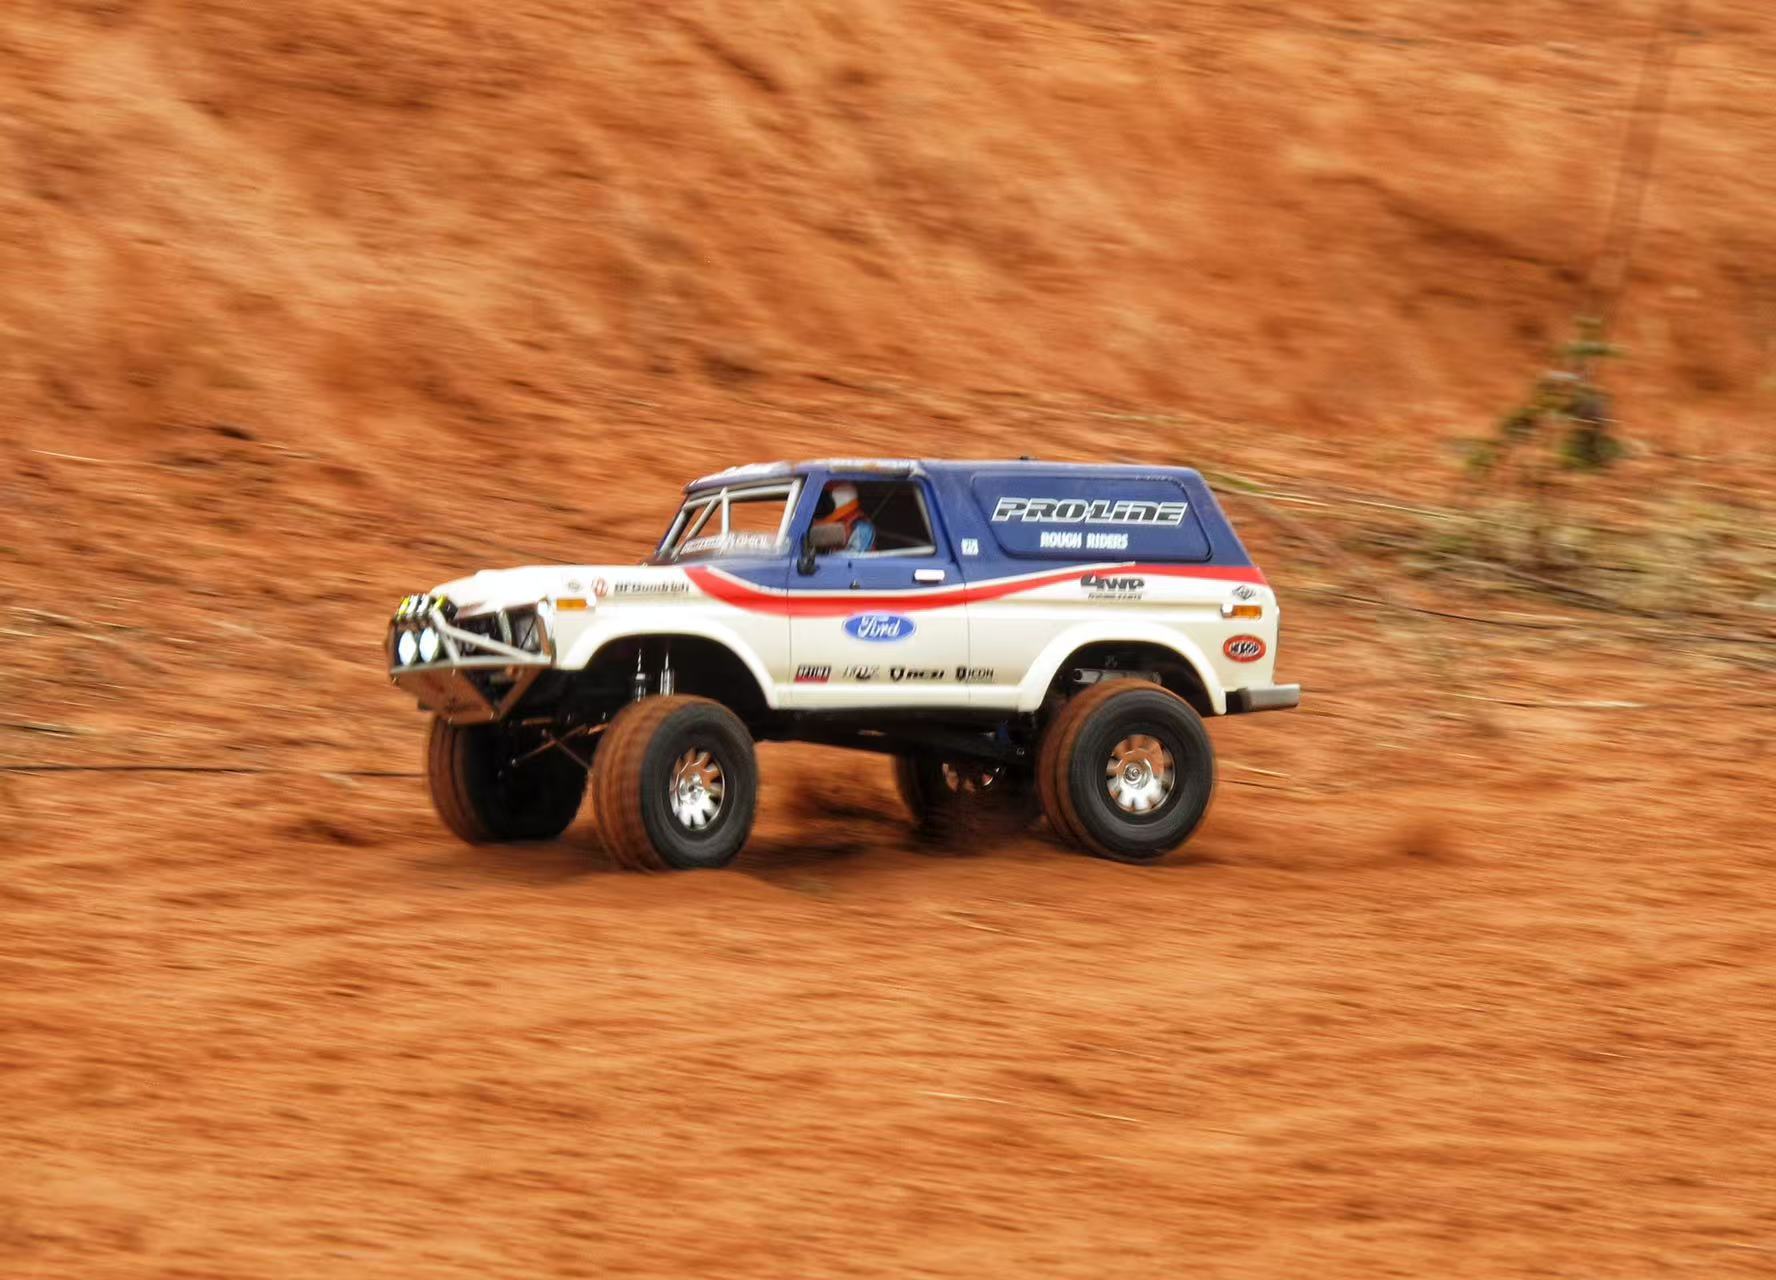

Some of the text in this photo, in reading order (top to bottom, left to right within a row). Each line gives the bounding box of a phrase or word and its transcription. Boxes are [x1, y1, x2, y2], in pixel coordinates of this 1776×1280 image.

[1040, 532, 1129, 550] ROUGH RIDERS
[857, 616, 901, 638] Ford
